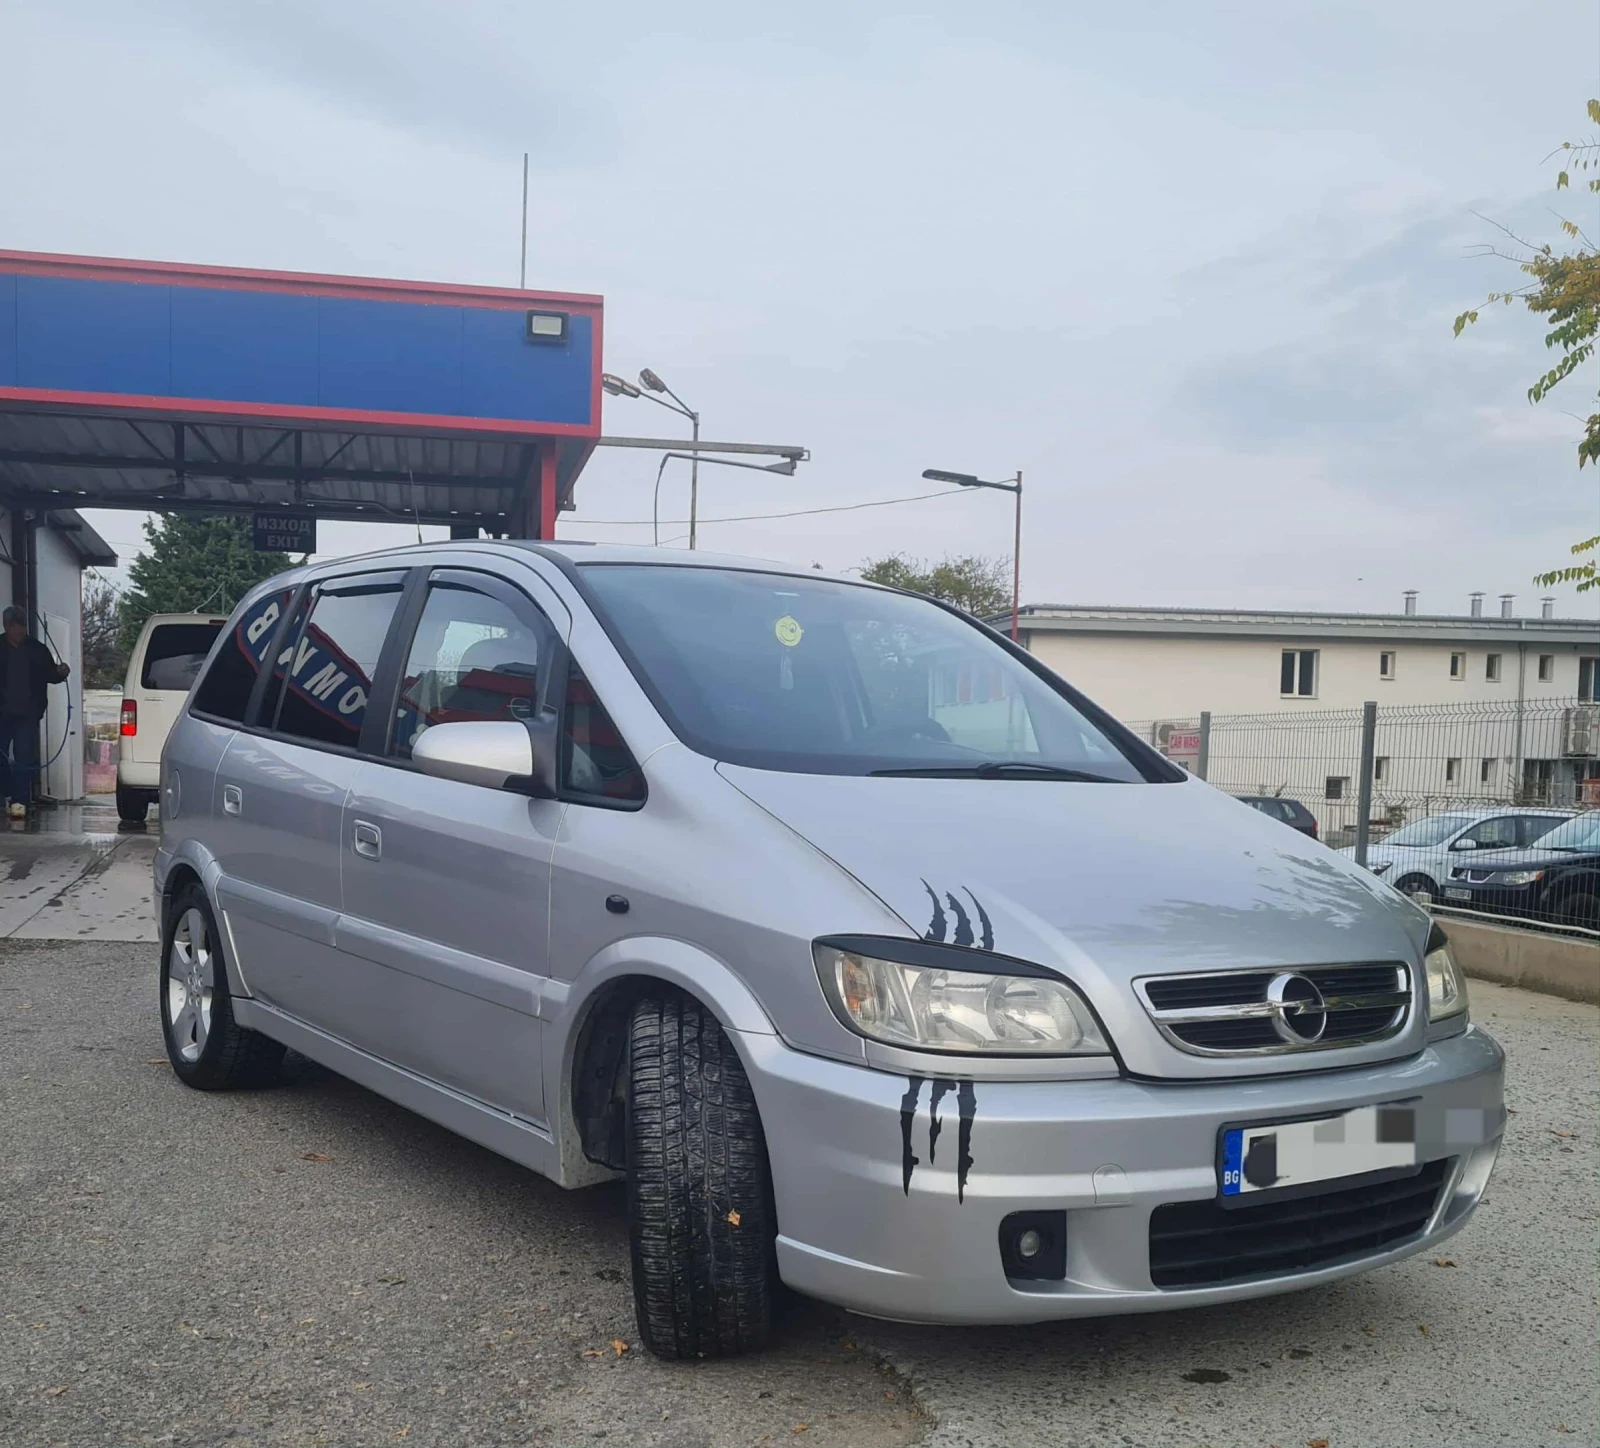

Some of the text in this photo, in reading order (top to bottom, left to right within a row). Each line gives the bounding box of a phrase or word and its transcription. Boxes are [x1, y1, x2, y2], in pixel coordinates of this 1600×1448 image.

[257, 518, 311, 534] ИЗХОД
[267, 535, 300, 548] EXIT
[1170, 735, 1183, 749] CAR
[1224, 1170, 1239, 1185] BG
